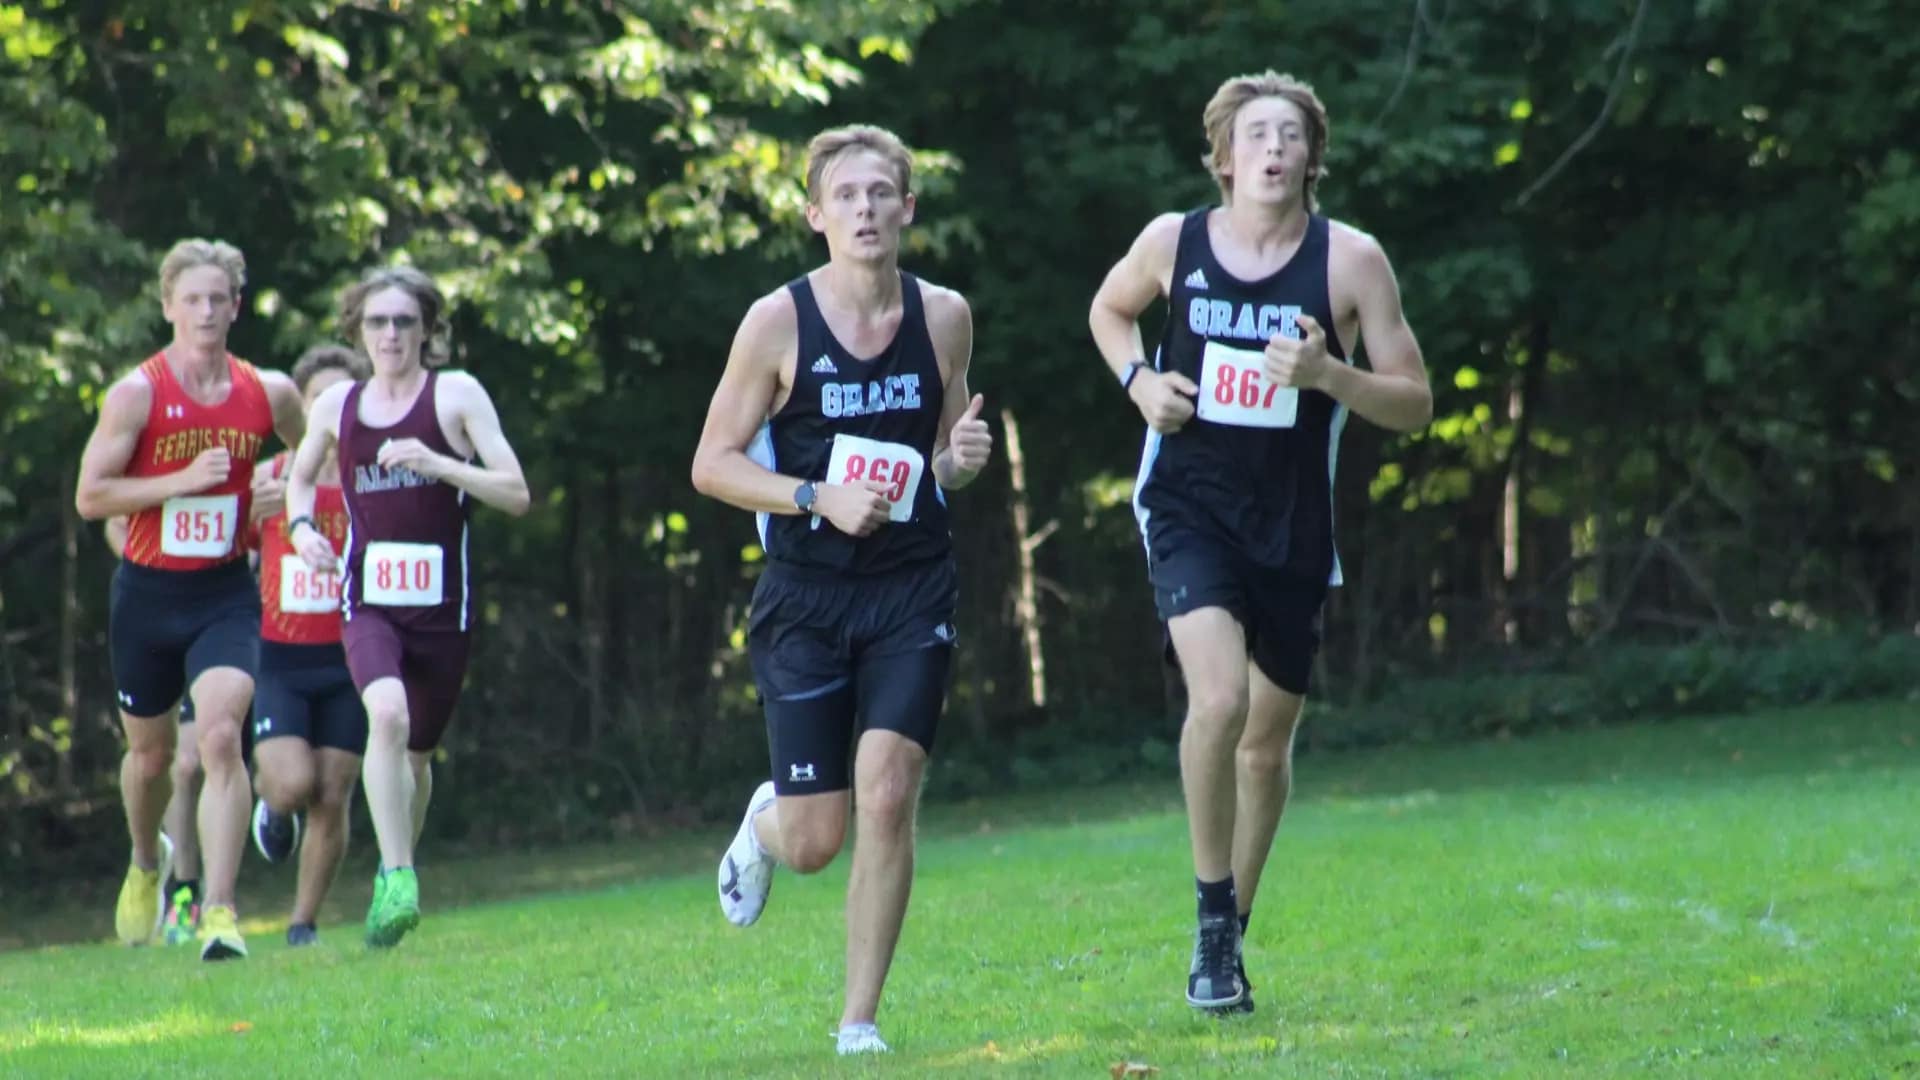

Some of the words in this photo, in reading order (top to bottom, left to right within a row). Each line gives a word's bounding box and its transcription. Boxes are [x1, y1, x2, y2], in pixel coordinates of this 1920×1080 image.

[1188, 297, 1302, 342] GRACE
[821, 373, 921, 418] GRACE
[153, 428, 213, 466] FERRIS
[842, 454, 911, 503] 869
[174, 510, 226, 542] 851
[376, 559, 431, 591] 810
